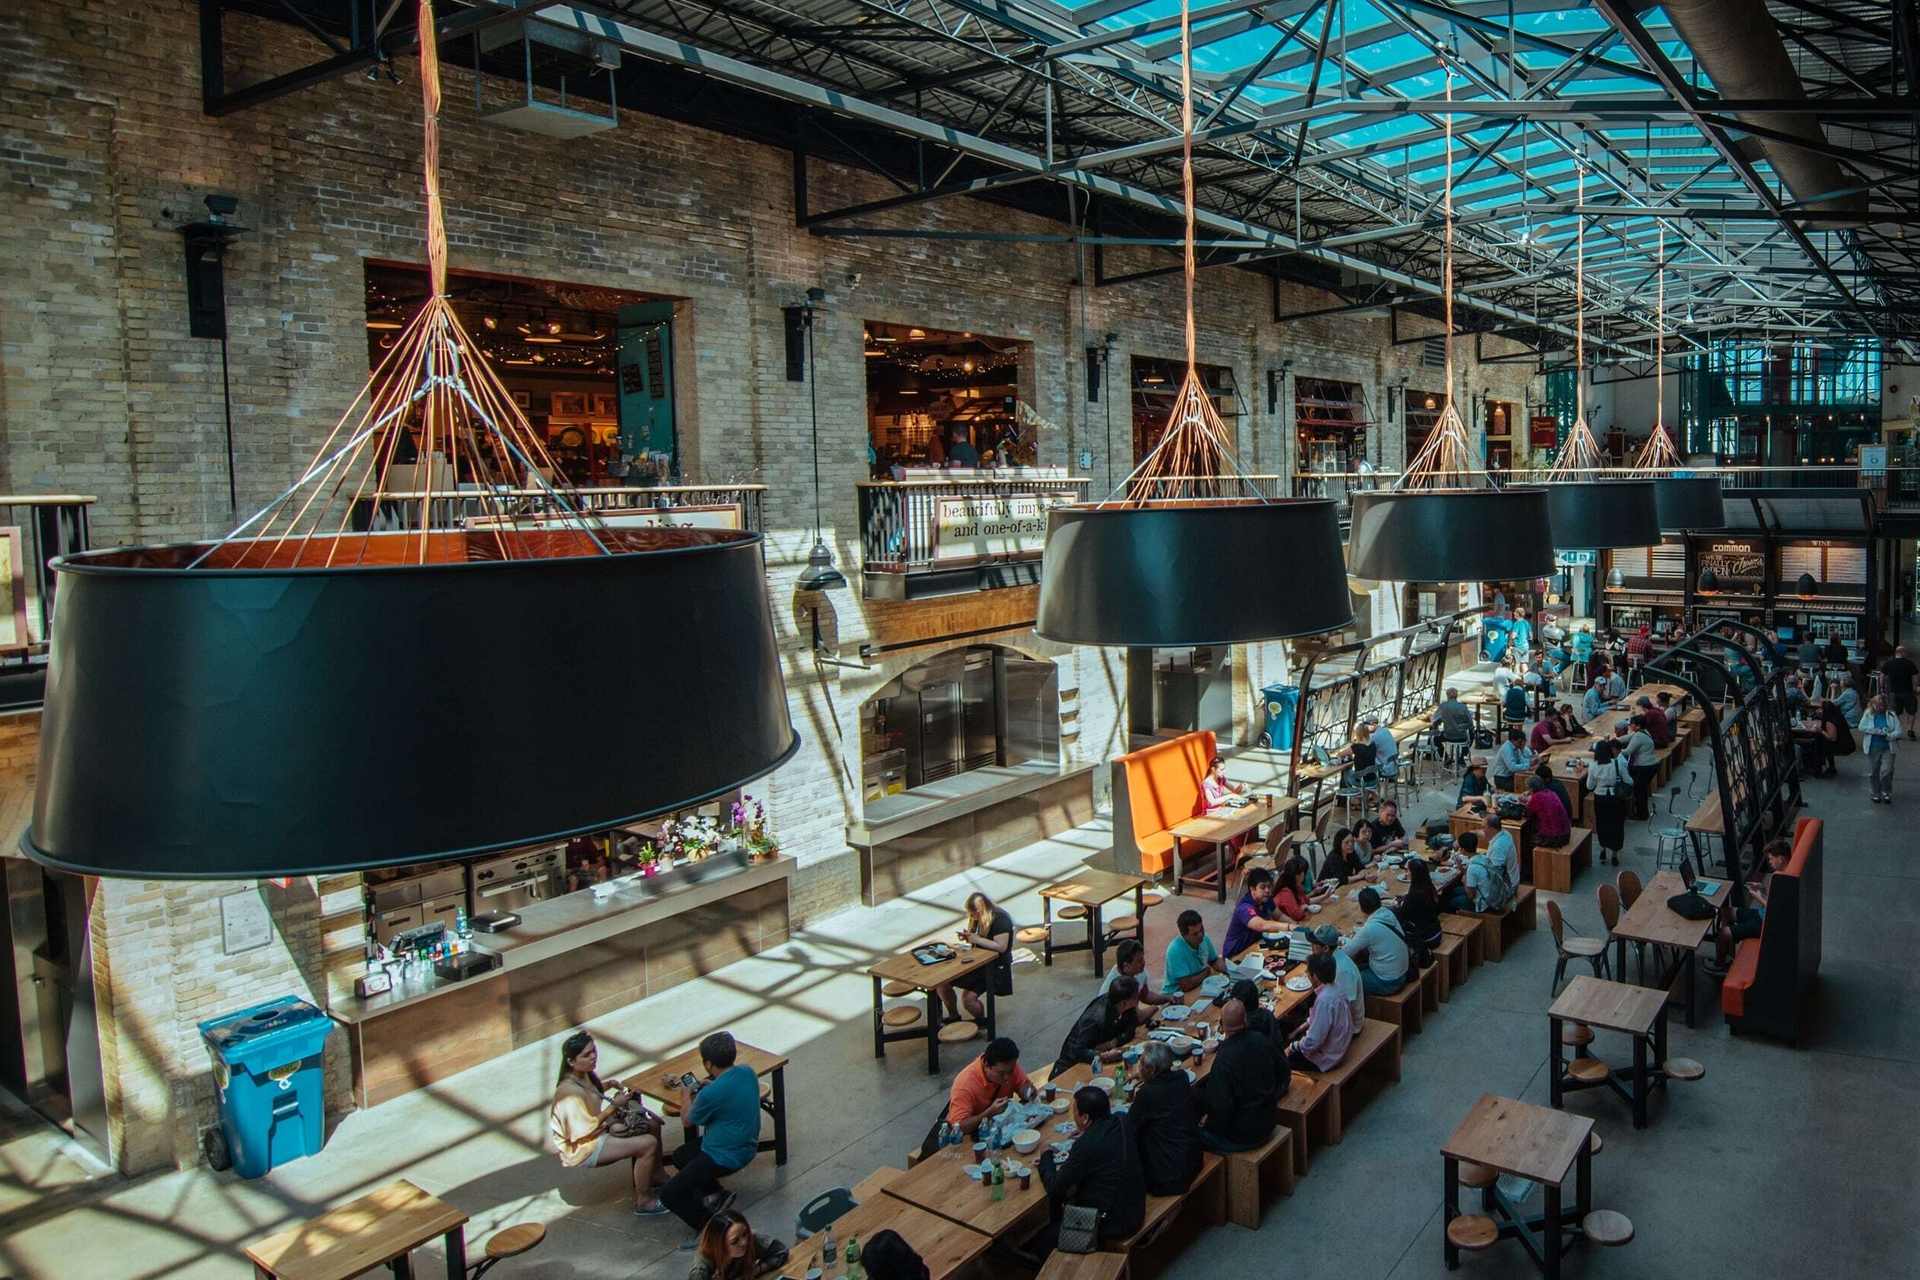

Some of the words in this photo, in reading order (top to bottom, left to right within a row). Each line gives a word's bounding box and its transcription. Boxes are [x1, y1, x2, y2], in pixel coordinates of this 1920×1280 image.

[943, 501, 1012, 519] beautifully
[954, 522, 979, 538] and
[983, 518, 1047, 535] one-of-a-ki
[1712, 544, 1751, 553] common
